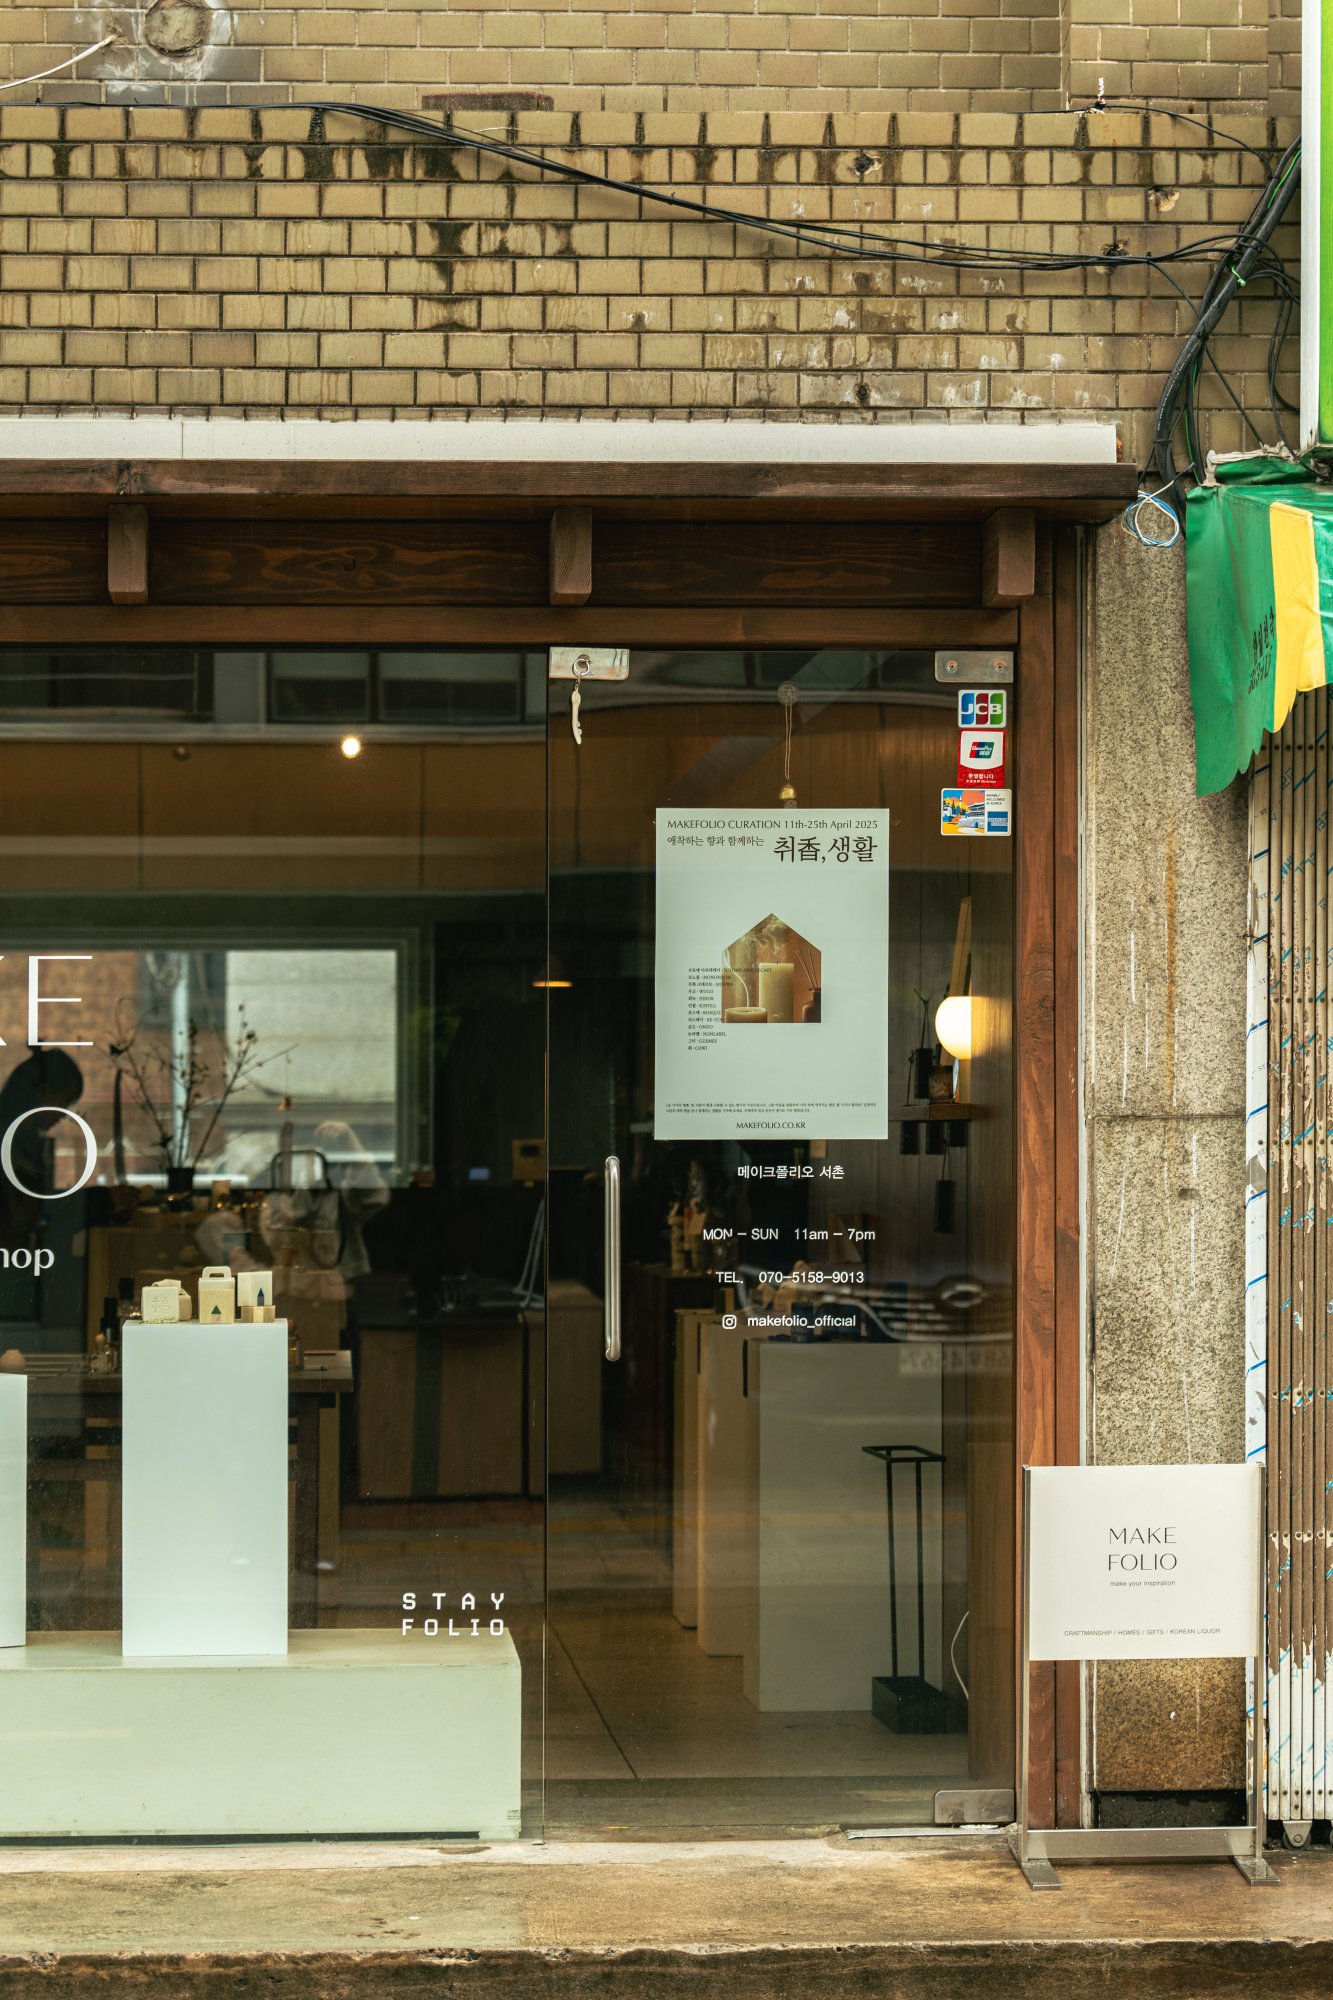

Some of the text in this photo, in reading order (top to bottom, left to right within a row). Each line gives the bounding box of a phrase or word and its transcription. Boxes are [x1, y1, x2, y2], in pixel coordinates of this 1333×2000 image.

[962, 703, 1002, 715] JCB
[667, 820, 878, 832] MAKEFOLIO CURATION 11th-25th April 2025
[667, 836, 704, 847] 애착하는
[707, 836, 725, 847] 향과
[728, 836, 765, 847] 함께하는
[735, 1121, 806, 1130] MAKEFOLIO.CO.KR
[1, 1106, 98, 1200] O
[737, 1165, 845, 1180] 메이크폴리오 서촌
[703, 1228, 733, 1240] MON
[751, 1228, 779, 1240] SUN
[794, 1228, 829, 1240] 11am
[848, 1228, 876, 1242] 7pm
[715, 1271, 865, 1284] TEL. 070-5158-9013
[747, 1314, 857, 1329] makefolio_official
[1109, 1526, 1177, 1545] MAKE
[1108, 1553, 1178, 1571] FOLIO
[1143, 1580, 1176, 1588] inspiration
[402, 1592, 505, 1611] STAY
[401, 1618, 504, 1636] FOLIO
